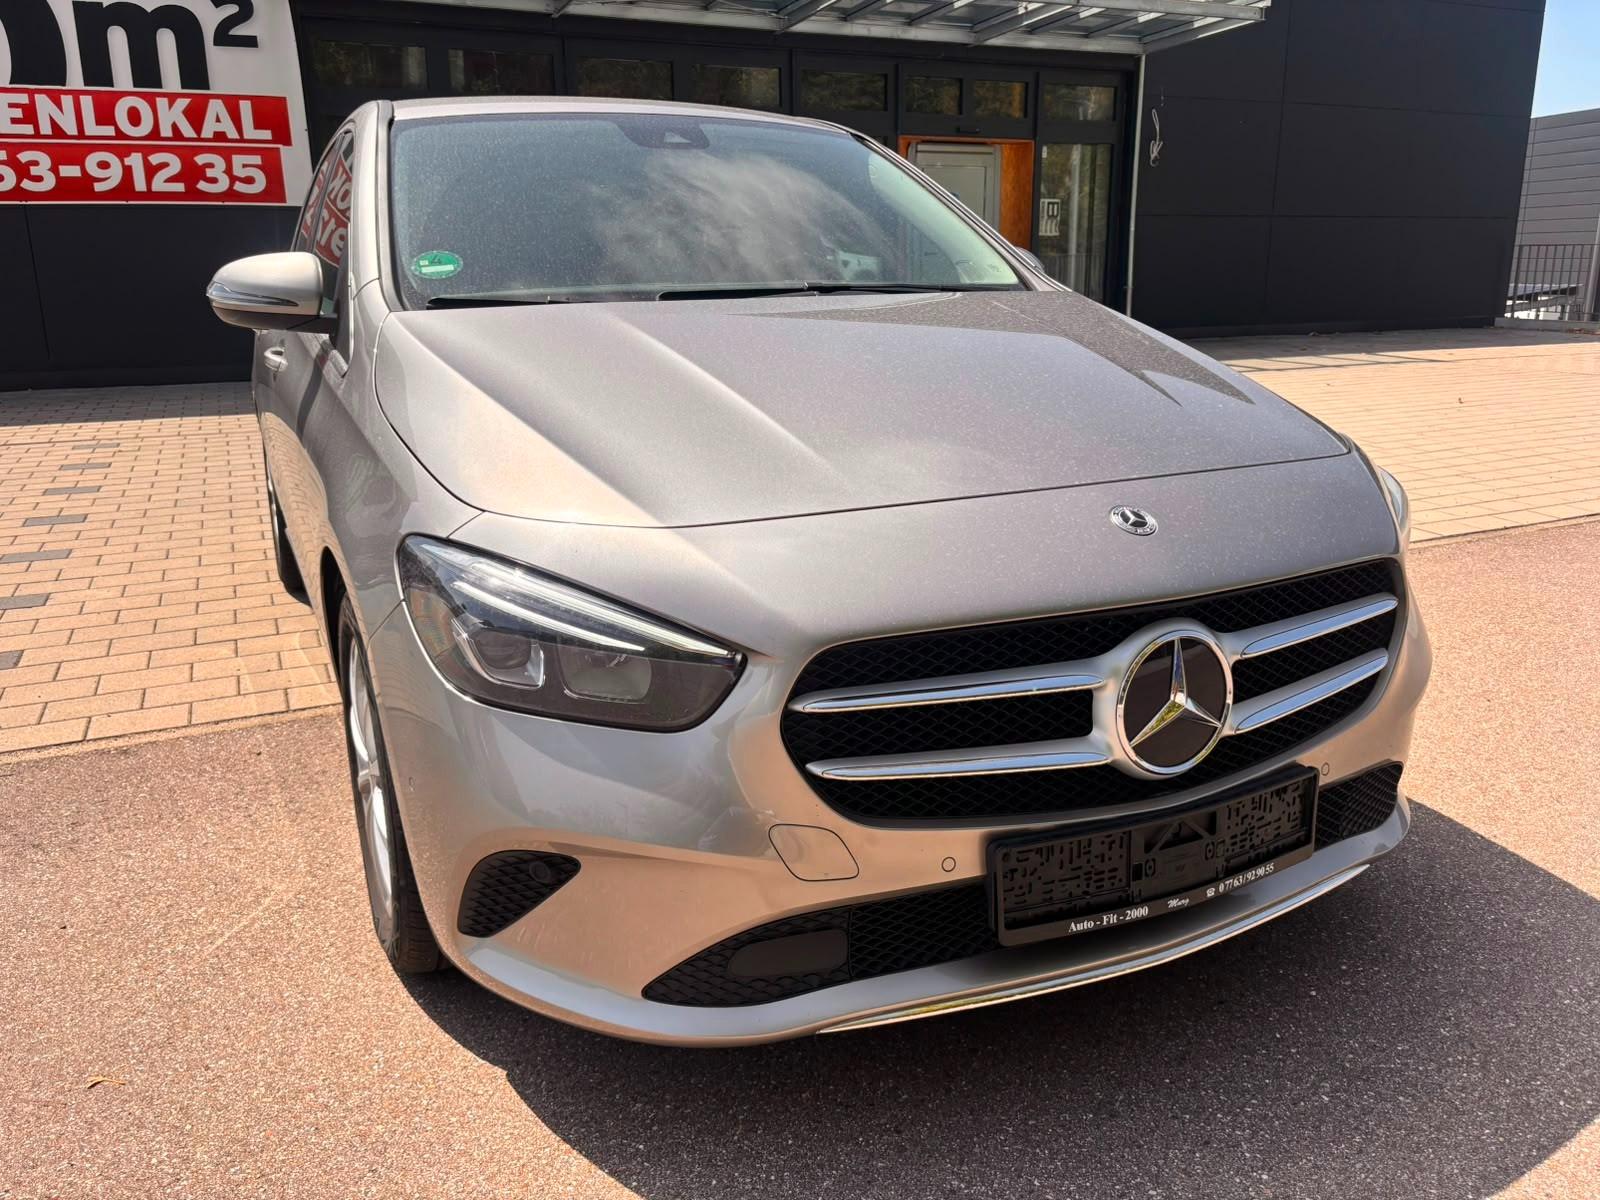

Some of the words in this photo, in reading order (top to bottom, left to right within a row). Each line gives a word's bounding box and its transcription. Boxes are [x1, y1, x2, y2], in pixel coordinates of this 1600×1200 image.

[1068, 919, 1094, 933] Auto
[1102, 913, 1118, 926] Fit
[1125, 905, 1149, 920] 2000
